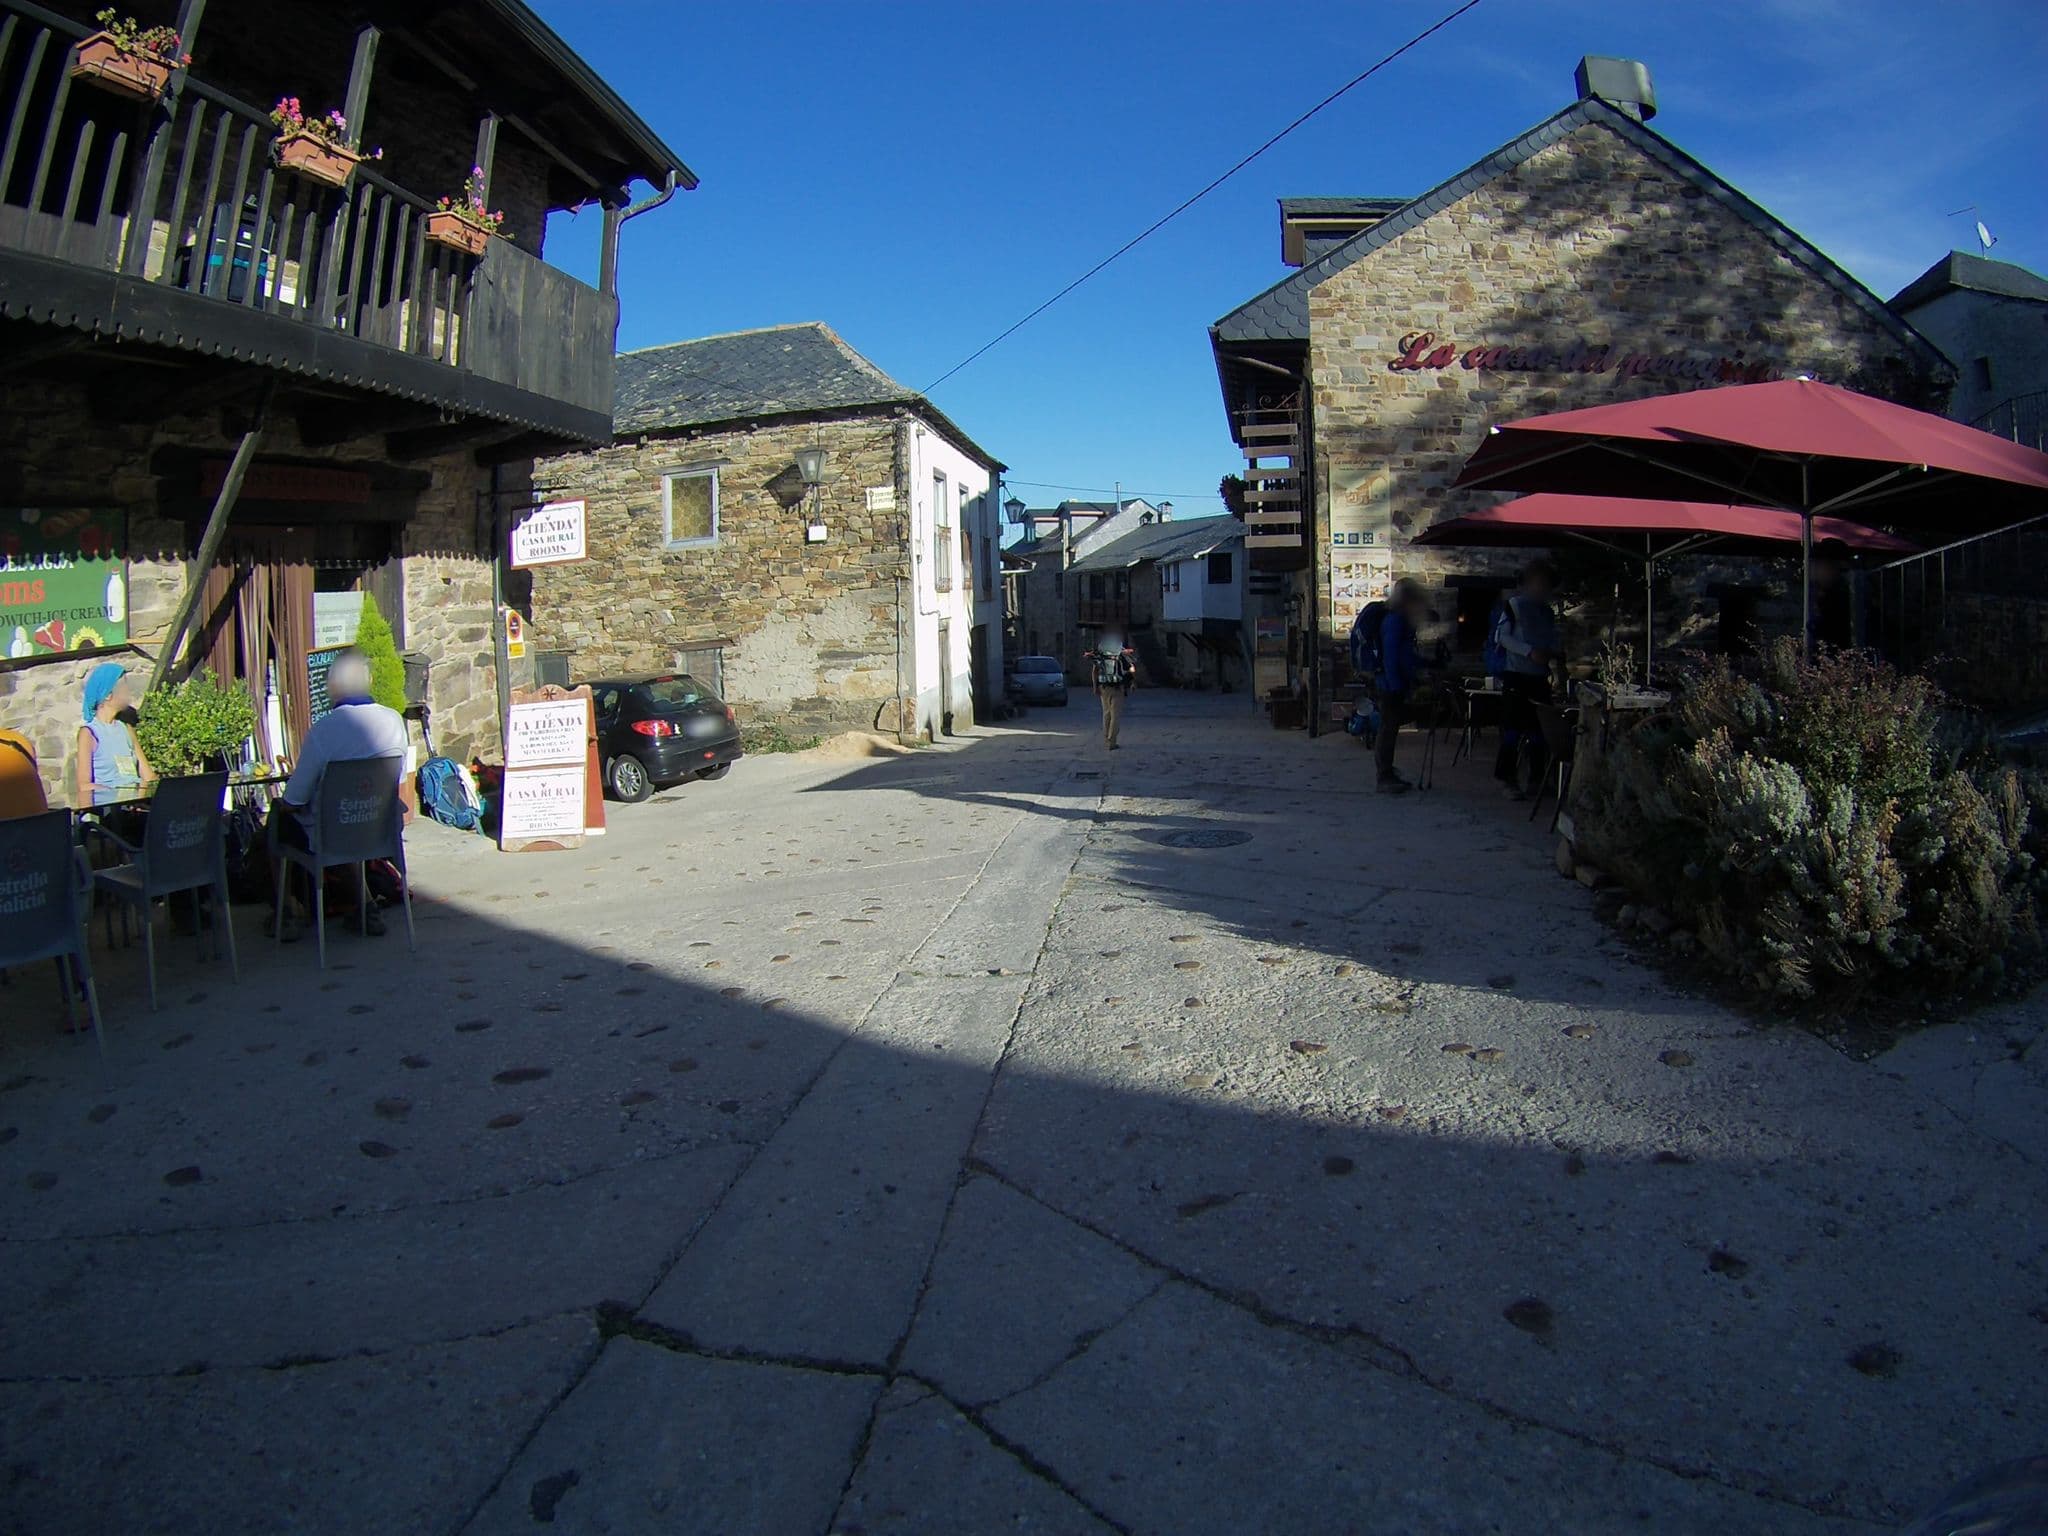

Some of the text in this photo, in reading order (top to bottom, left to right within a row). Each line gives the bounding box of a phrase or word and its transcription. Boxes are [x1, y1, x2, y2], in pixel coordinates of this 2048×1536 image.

[1387, 332, 1456, 371] La
[1460, 343, 1552, 371] casa
[522, 532, 576, 546] CASA RURAL
[529, 545, 566, 557] ROOMS
[0, 579, 45, 606] ms
[70, 606, 113, 622] CREAM
[513, 721, 530, 732] LA
[534, 716, 583, 730] TIENDA
[508, 787, 575, 799] CASA RURAL
